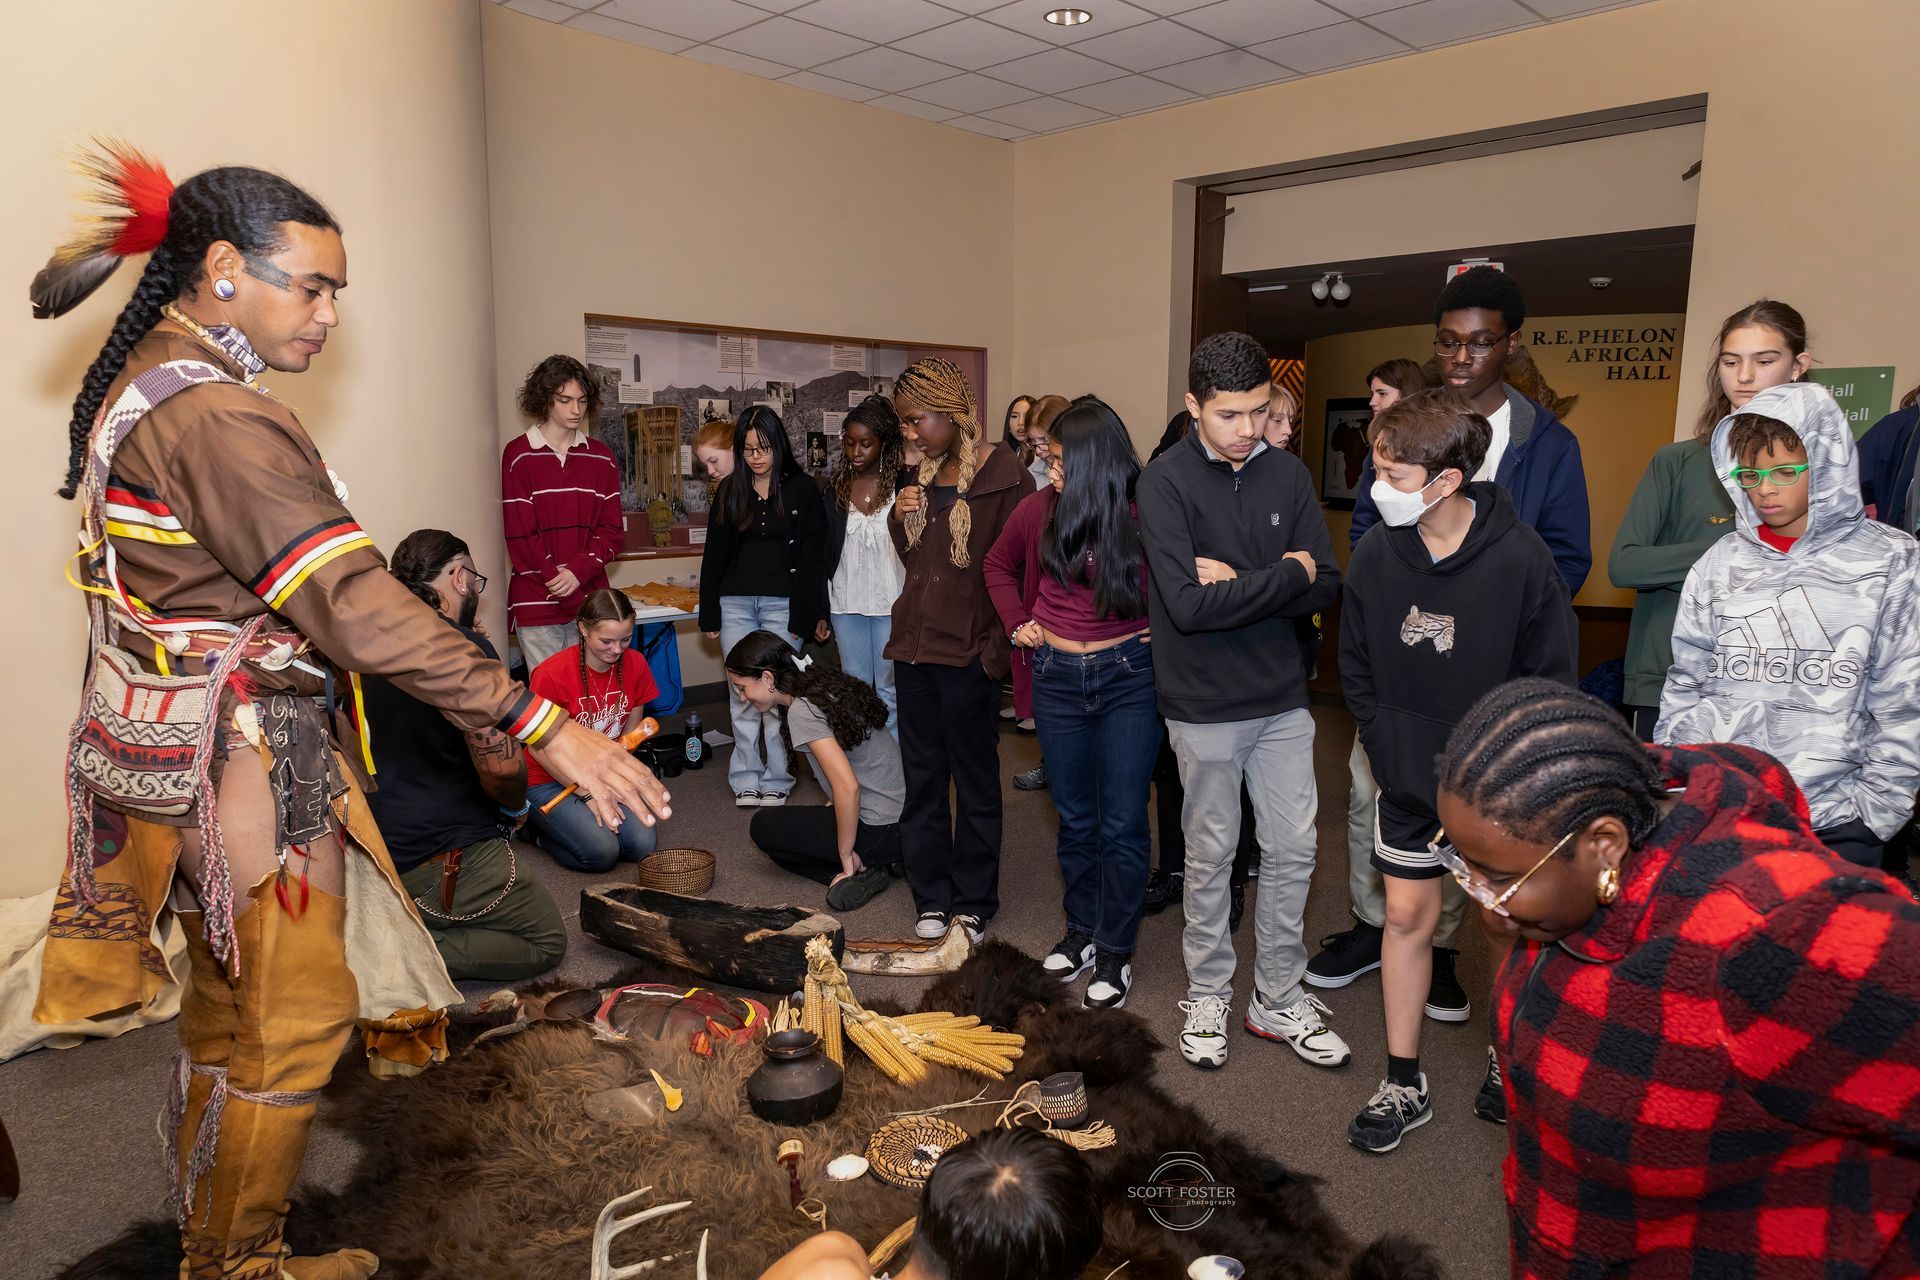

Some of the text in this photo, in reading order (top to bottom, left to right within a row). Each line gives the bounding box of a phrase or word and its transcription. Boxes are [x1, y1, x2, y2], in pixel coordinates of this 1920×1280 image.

[1577, 328, 1676, 344] PHELON
[1567, 347, 1674, 362] AFRICAN
[1606, 365, 1671, 380] HALL
[1707, 646, 1859, 689] adidas
